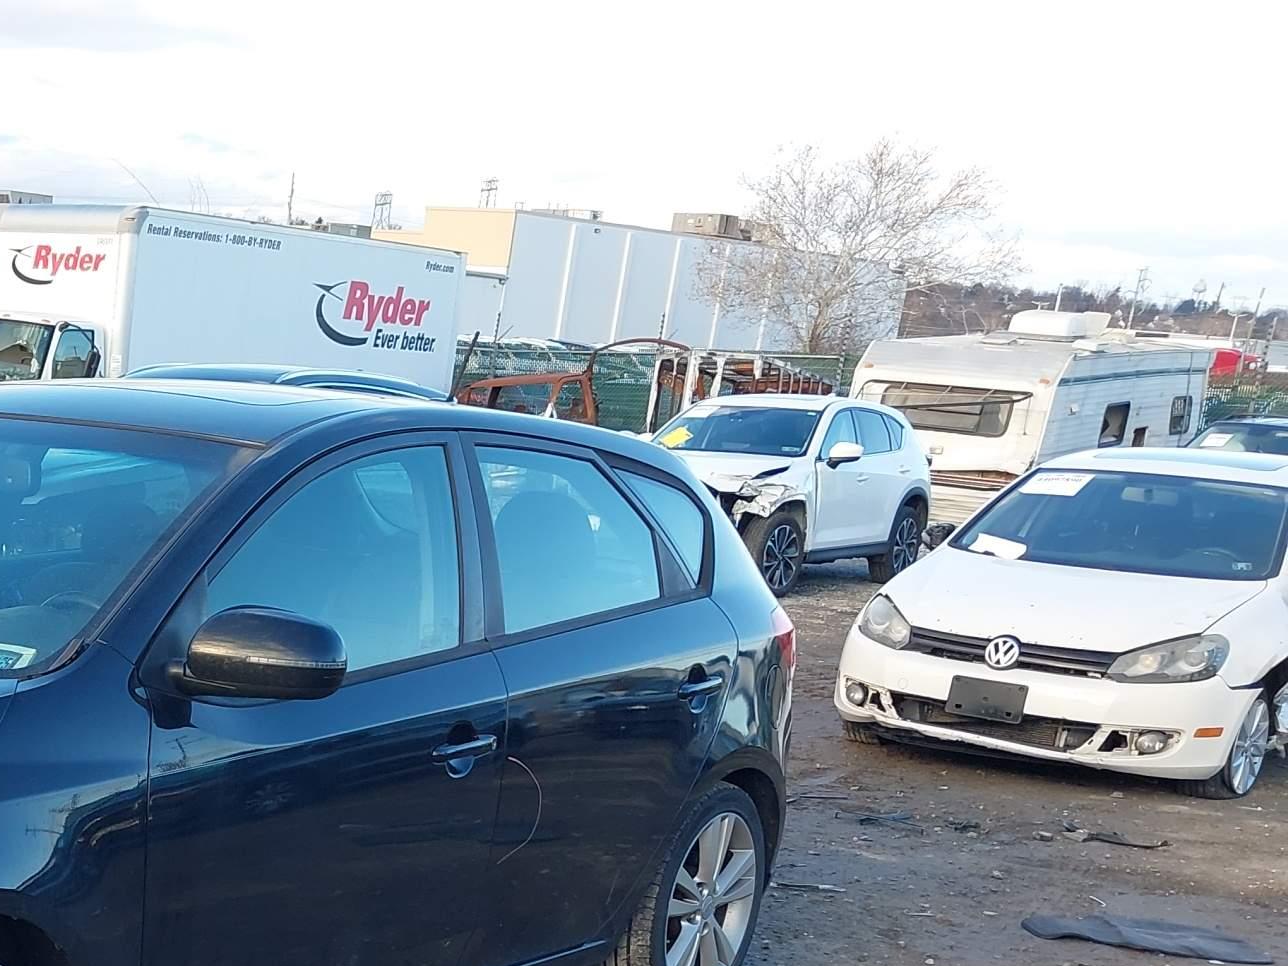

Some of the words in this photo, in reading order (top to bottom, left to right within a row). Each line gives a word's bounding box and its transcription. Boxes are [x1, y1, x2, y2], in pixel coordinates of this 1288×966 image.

[147, 223, 172, 237] Rental
[173, 226, 223, 243] Reservations:
[224, 233, 282, 250] 1-800-BY-RYDER
[33, 245, 106, 276] Ryder
[425, 260, 455, 274] Ryder.com
[342, 280, 431, 332] Ryder
[373, 328, 400, 350] Ever
[400, 330, 436, 353] better.
